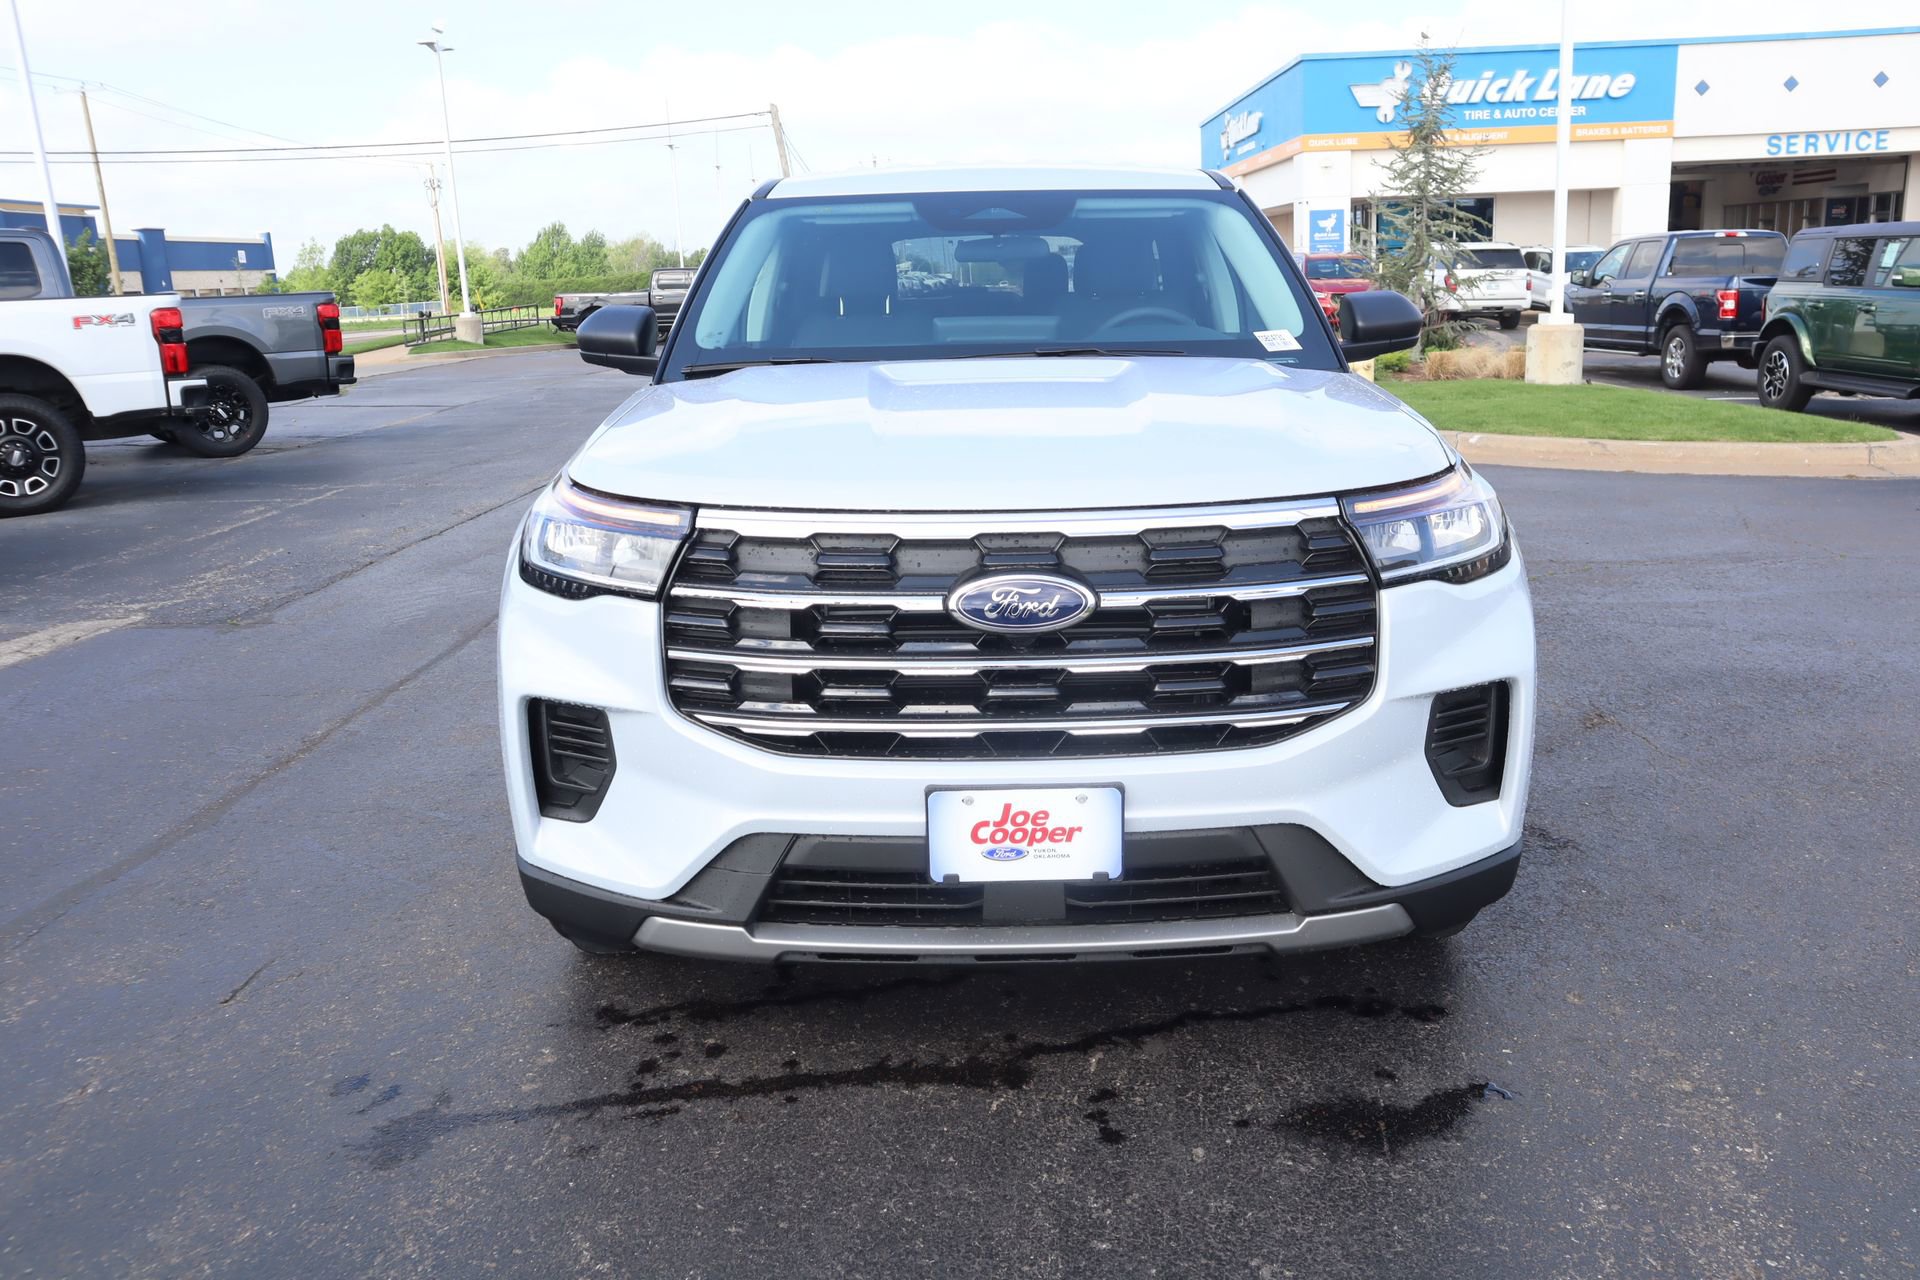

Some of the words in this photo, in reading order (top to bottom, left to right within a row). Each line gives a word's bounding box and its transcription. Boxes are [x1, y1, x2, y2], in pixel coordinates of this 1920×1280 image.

[1421, 69, 1536, 106] Quick
[1532, 68, 1637, 101] Lane
[1464, 109, 1490, 121] TIRE
[1493, 109, 1502, 119] &
[1504, 107, 1537, 118] AUTO
[1539, 105, 1586, 117] CEER
[1575, 127, 1611, 137] BRAKES
[1621, 125, 1668, 135] BATTERIES
[1308, 138, 1335, 147] QUICK
[1766, 130, 1889, 155] SERVICE
[73, 312, 136, 330] FX4
[984, 586, 1061, 619] Ford
[992, 802, 1050, 828] Joe
[970, 820, 1083, 847] Cooper
[993, 847, 1018, 858] Ford
